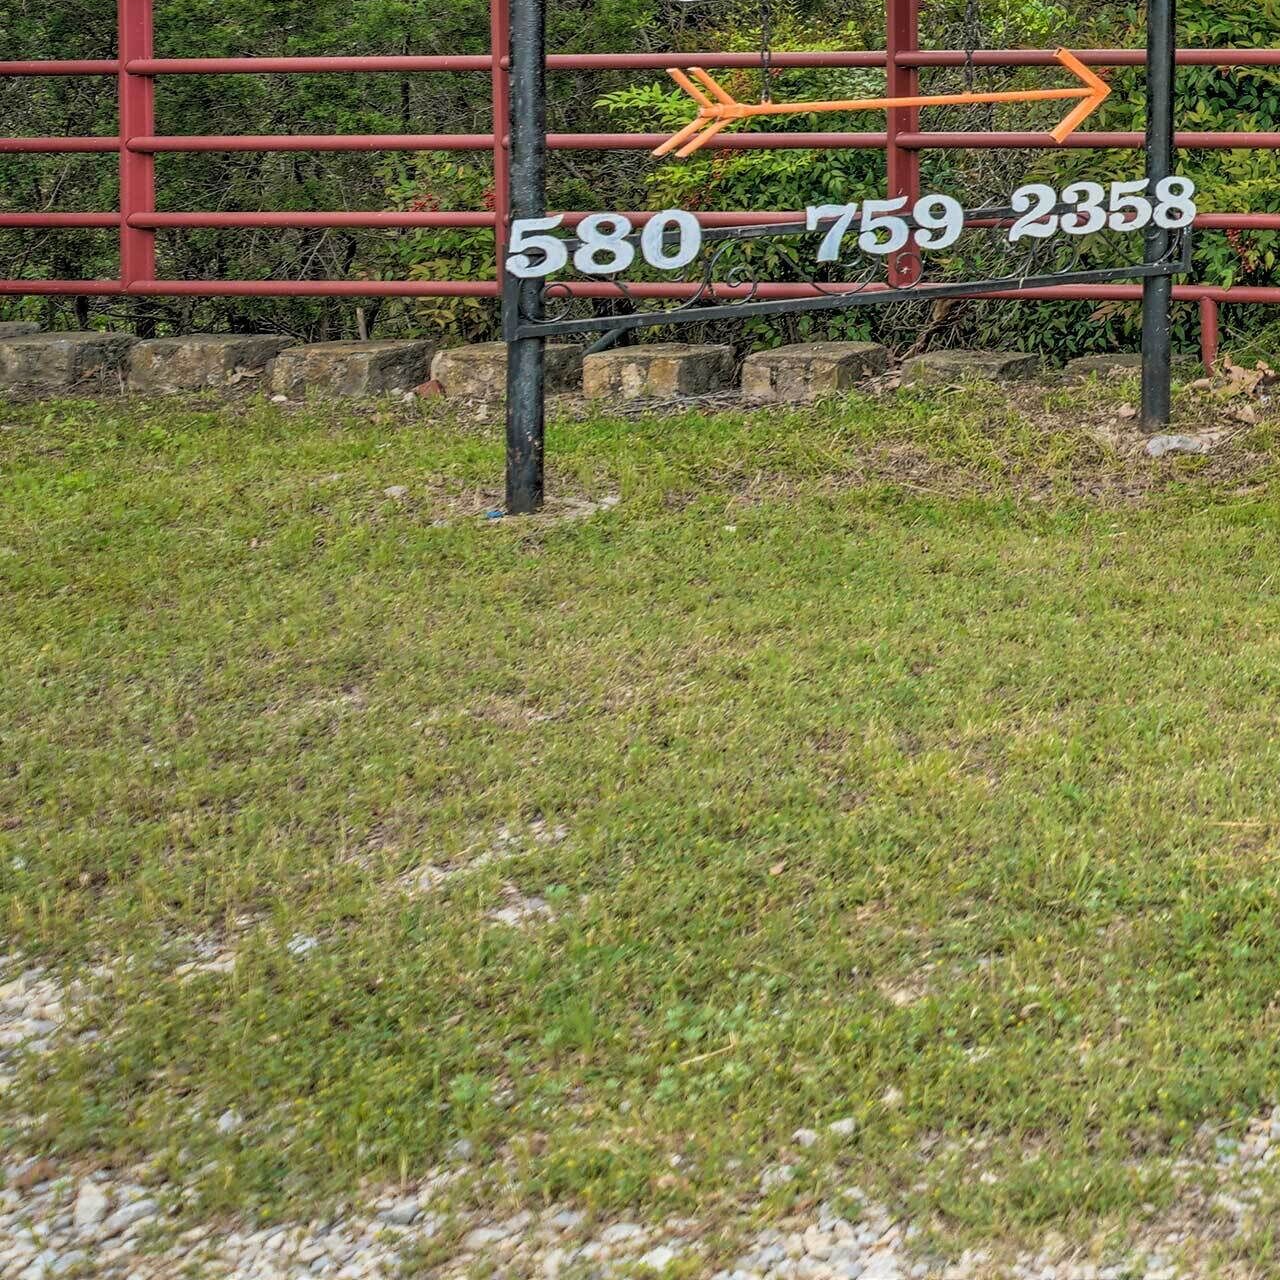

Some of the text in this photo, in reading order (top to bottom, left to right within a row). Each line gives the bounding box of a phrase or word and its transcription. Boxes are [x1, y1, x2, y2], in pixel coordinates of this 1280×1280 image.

[505, 176, 1197, 278] 580 759 2358
